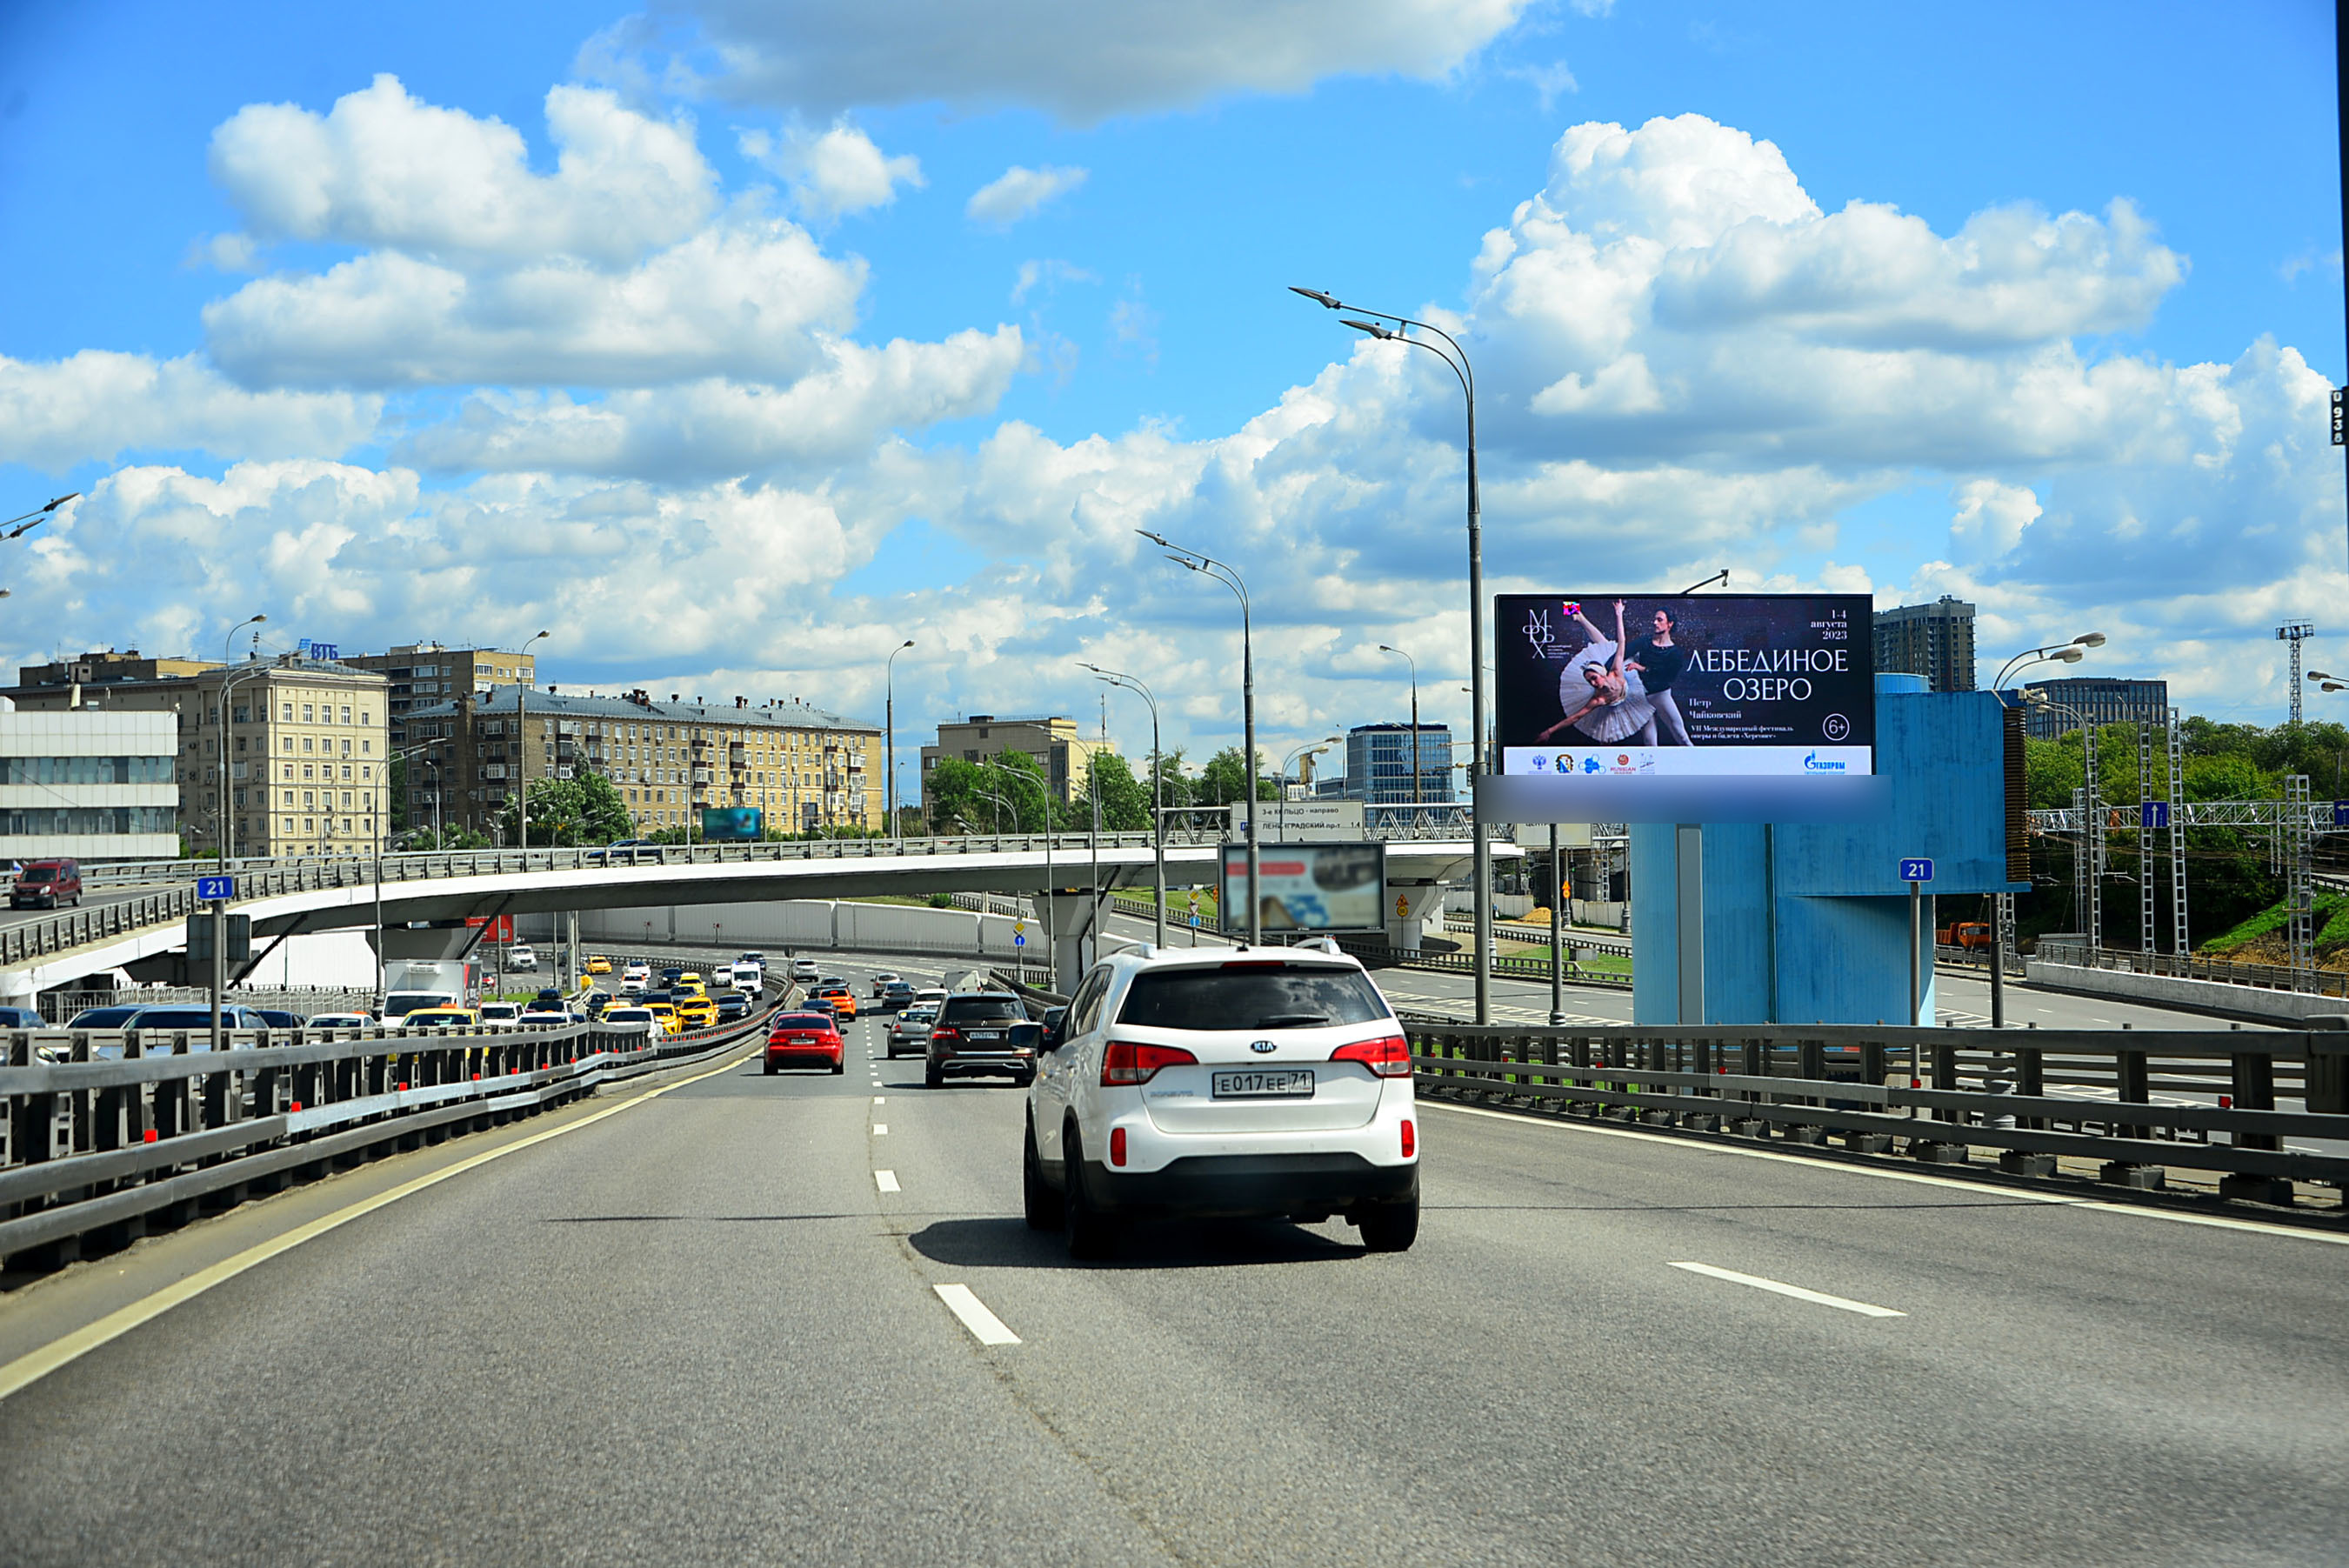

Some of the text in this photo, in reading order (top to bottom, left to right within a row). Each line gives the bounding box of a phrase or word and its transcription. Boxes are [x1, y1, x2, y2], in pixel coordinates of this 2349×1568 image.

[1810, 621, 1848, 631] августа
[1822, 630, 1848, 640] 2023
[311, 643, 338, 660] ВТБ
[1686, 649, 1849, 675] ЛЕБЕДИНОЕ
[1723, 677, 1812, 701] ОЗЕРО
[1689, 697, 1712, 710] Петр
[1689, 710, 1742, 719] Чайковский
[1828, 719, 1845, 735] 6+
[1908, 864, 1925, 877] 21
[207, 880, 224, 895] 21
[1253, 1042, 1274, 1051] KIA
